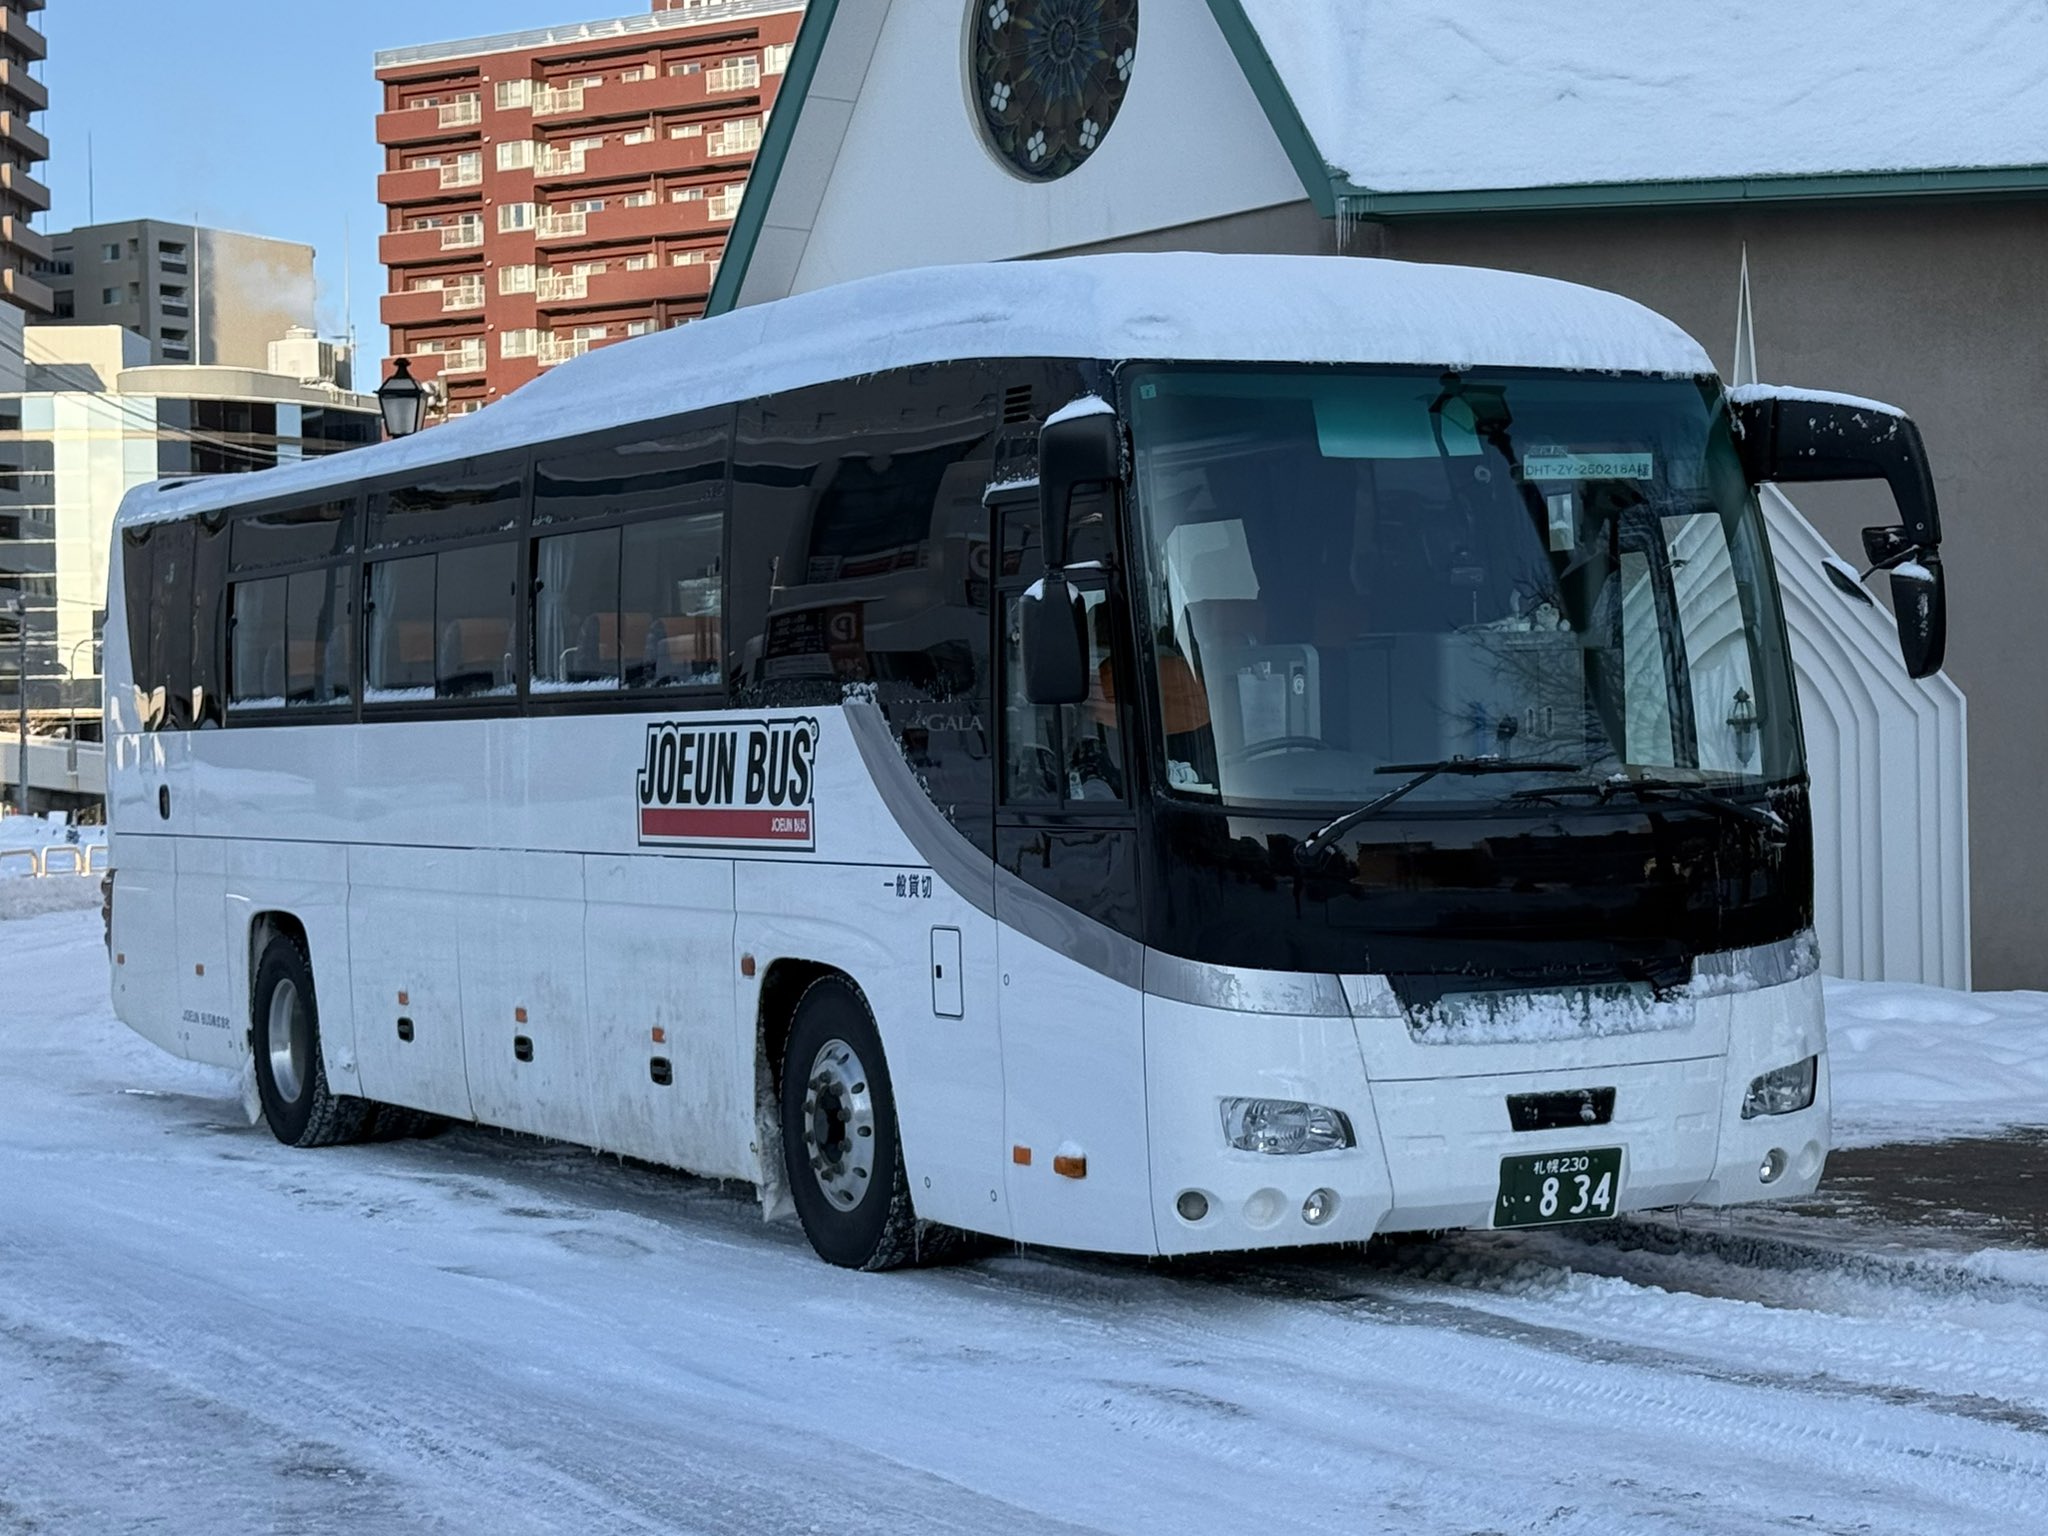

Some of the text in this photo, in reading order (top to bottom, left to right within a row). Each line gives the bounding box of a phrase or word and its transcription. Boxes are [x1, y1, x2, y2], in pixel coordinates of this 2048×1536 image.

[926, 713, 984, 732] GALA
[640, 728, 811, 806] JOEUN BUS
[771, 817, 807, 833] JOEUN BUS
[883, 873, 932, 898] 一般貸切
